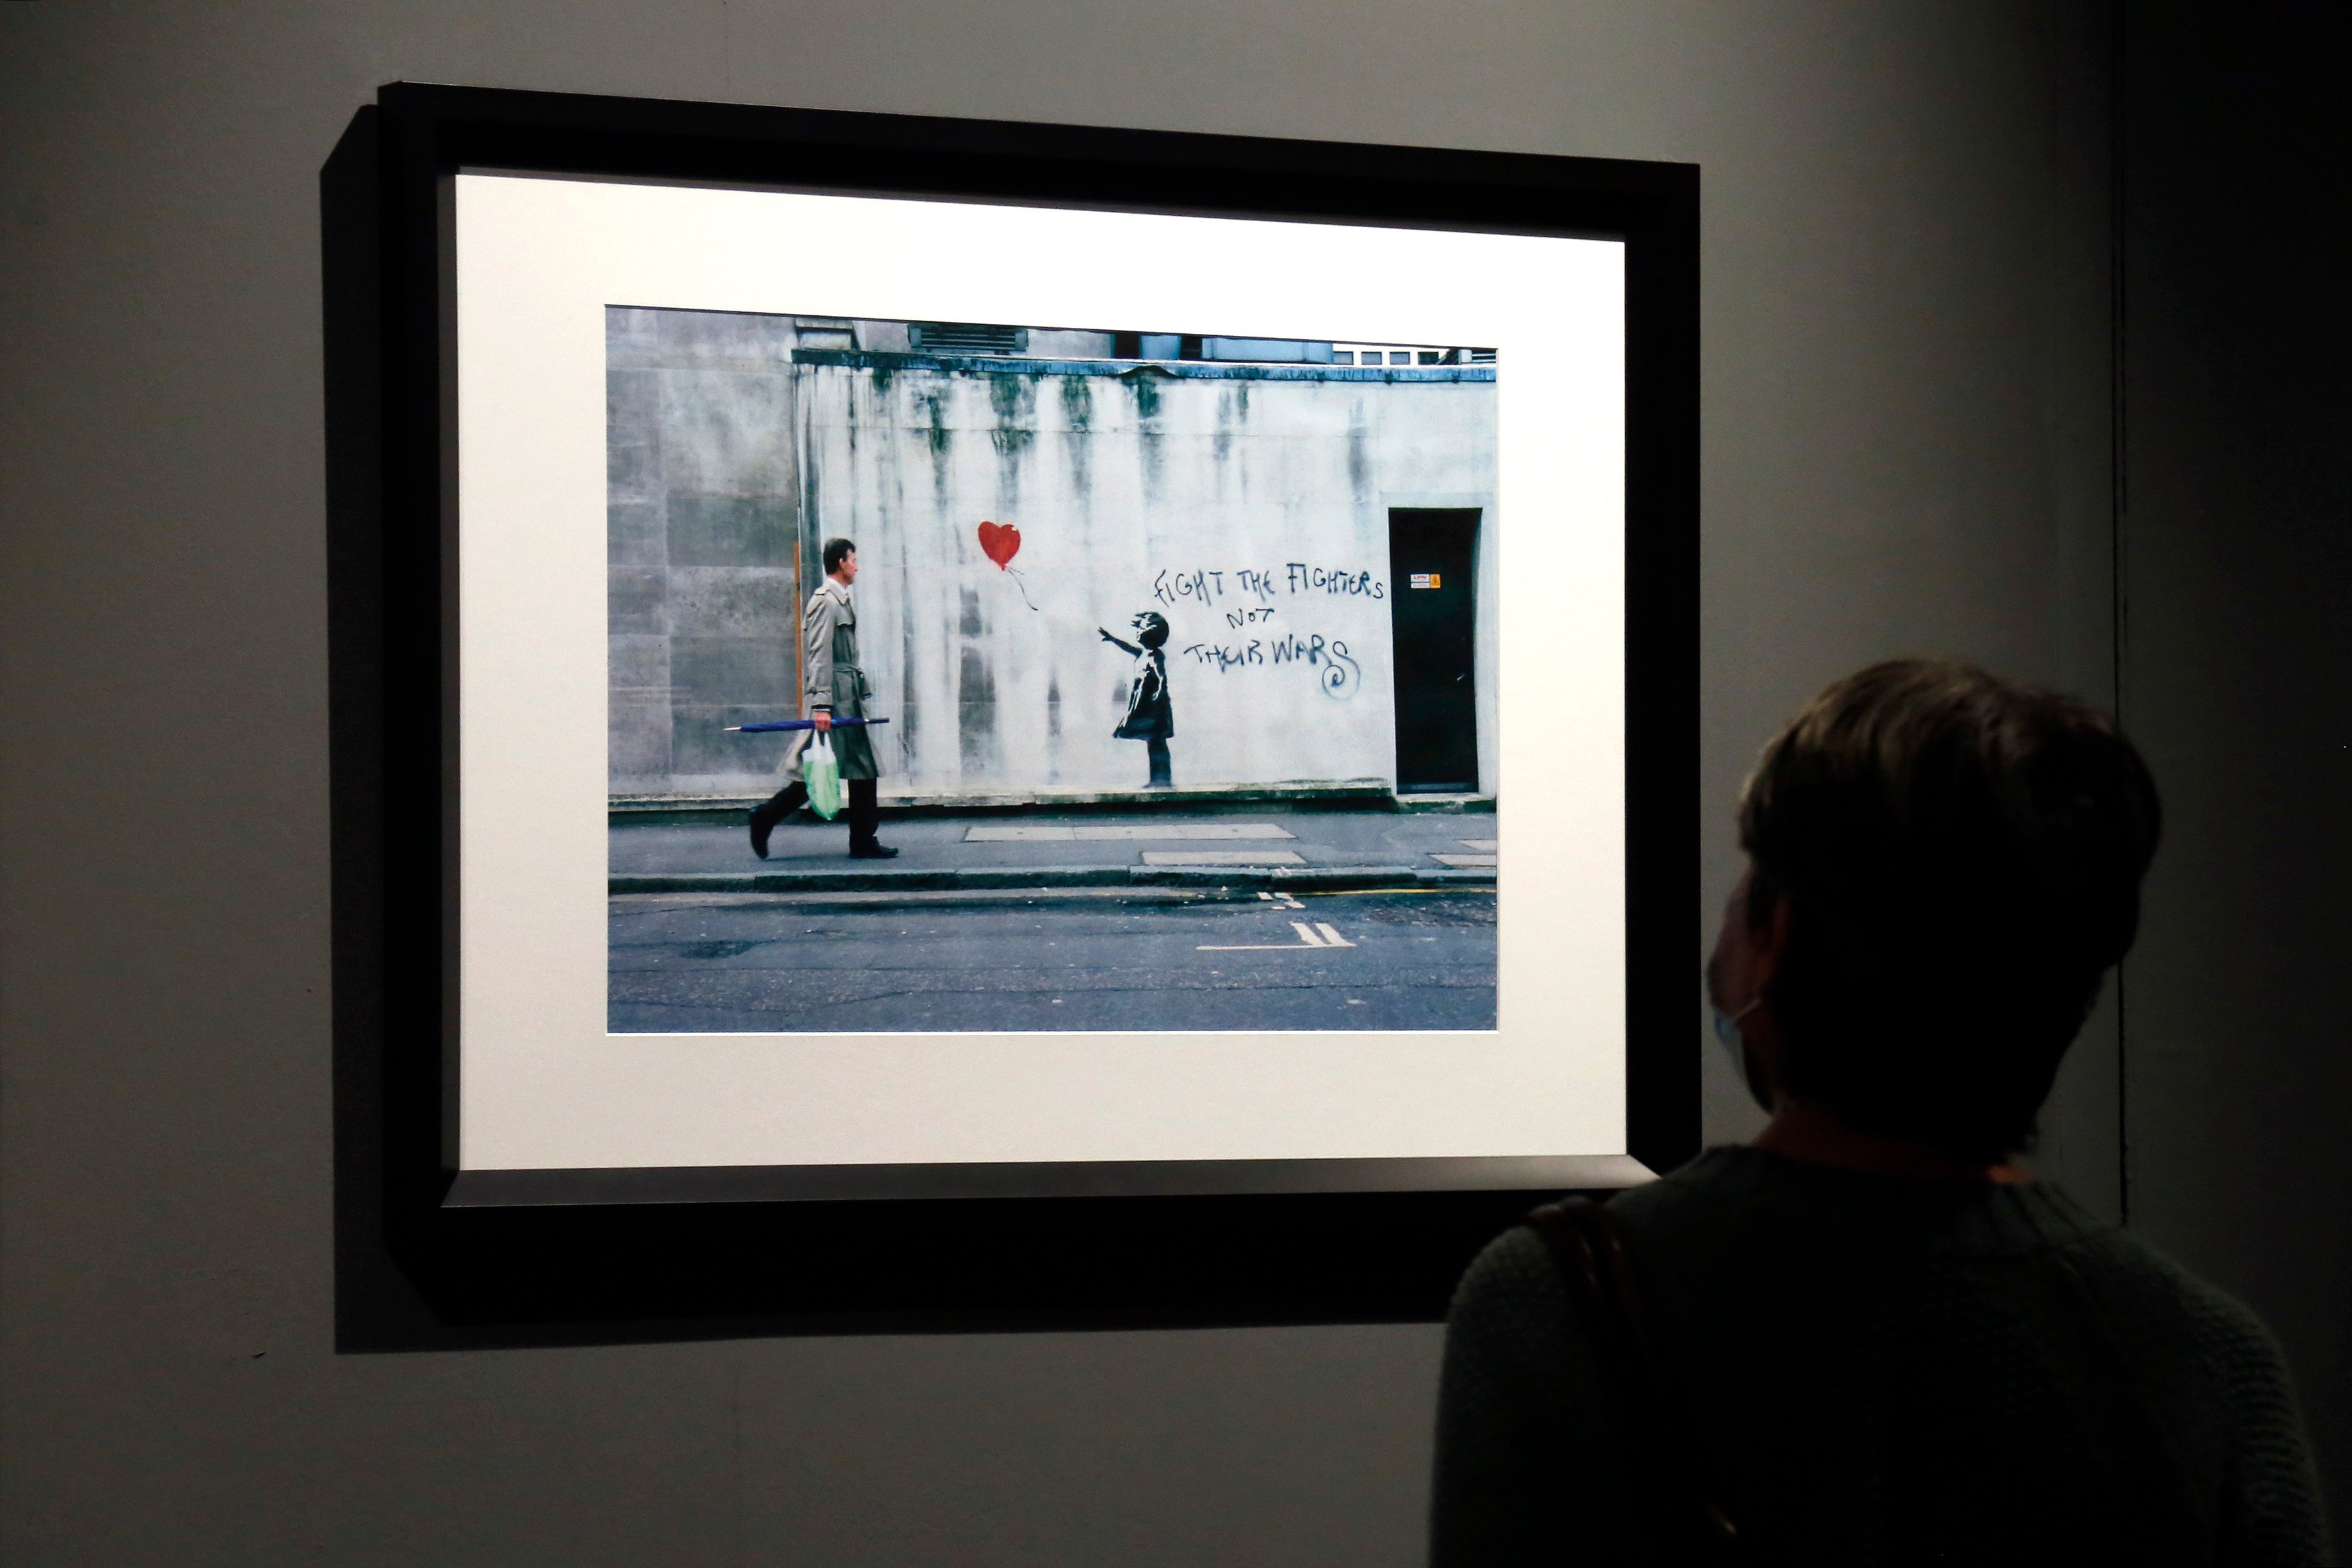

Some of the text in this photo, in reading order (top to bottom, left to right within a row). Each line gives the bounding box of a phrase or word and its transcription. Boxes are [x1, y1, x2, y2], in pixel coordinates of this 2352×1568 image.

[1154, 563, 1384, 607] FIGHT THE FIGHTERS
[1226, 608, 1275, 630] NOT
[1271, 634, 1362, 700] WARS
